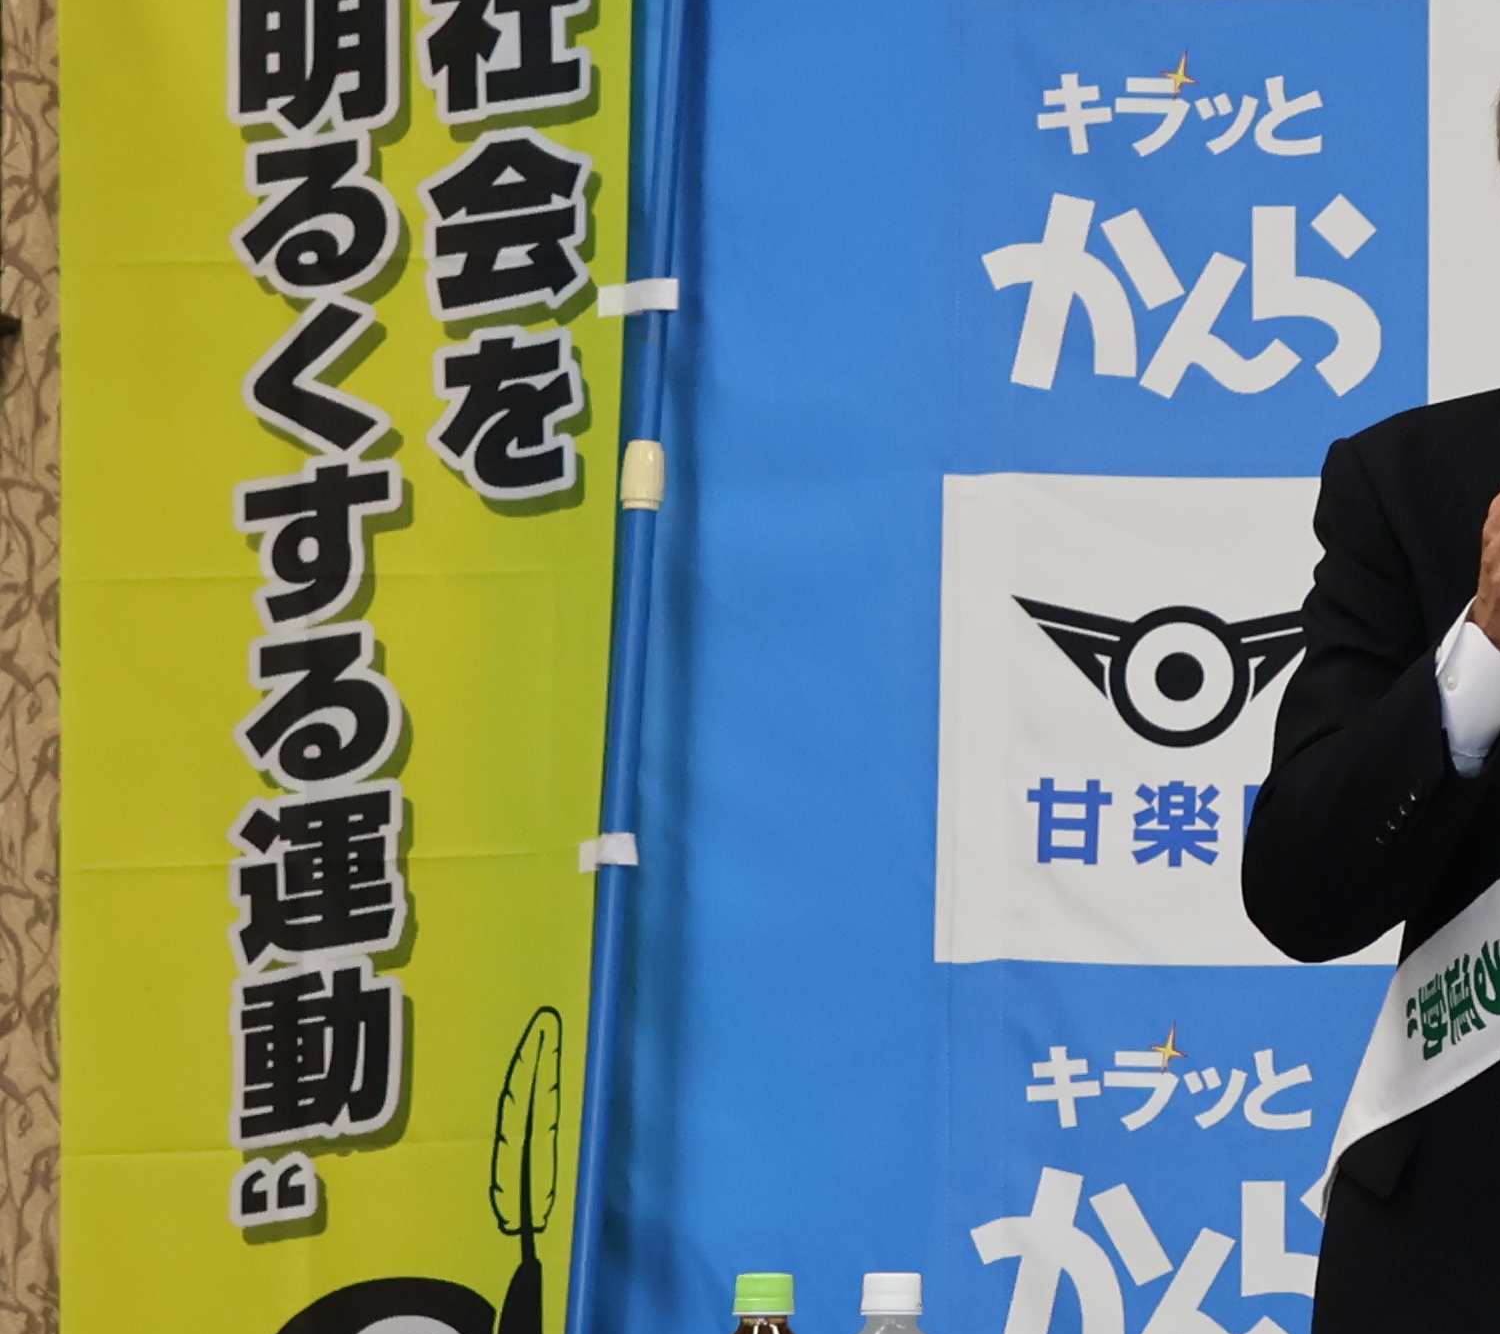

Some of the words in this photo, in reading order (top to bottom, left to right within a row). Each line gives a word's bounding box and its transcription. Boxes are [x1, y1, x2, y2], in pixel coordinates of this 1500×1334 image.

[1038, 72, 1322, 156] キラッと
[983, 194, 1381, 398] かんら
[1027, 777, 1262, 867] 甘楽
[1027, 1046, 1312, 1130] キラッと
